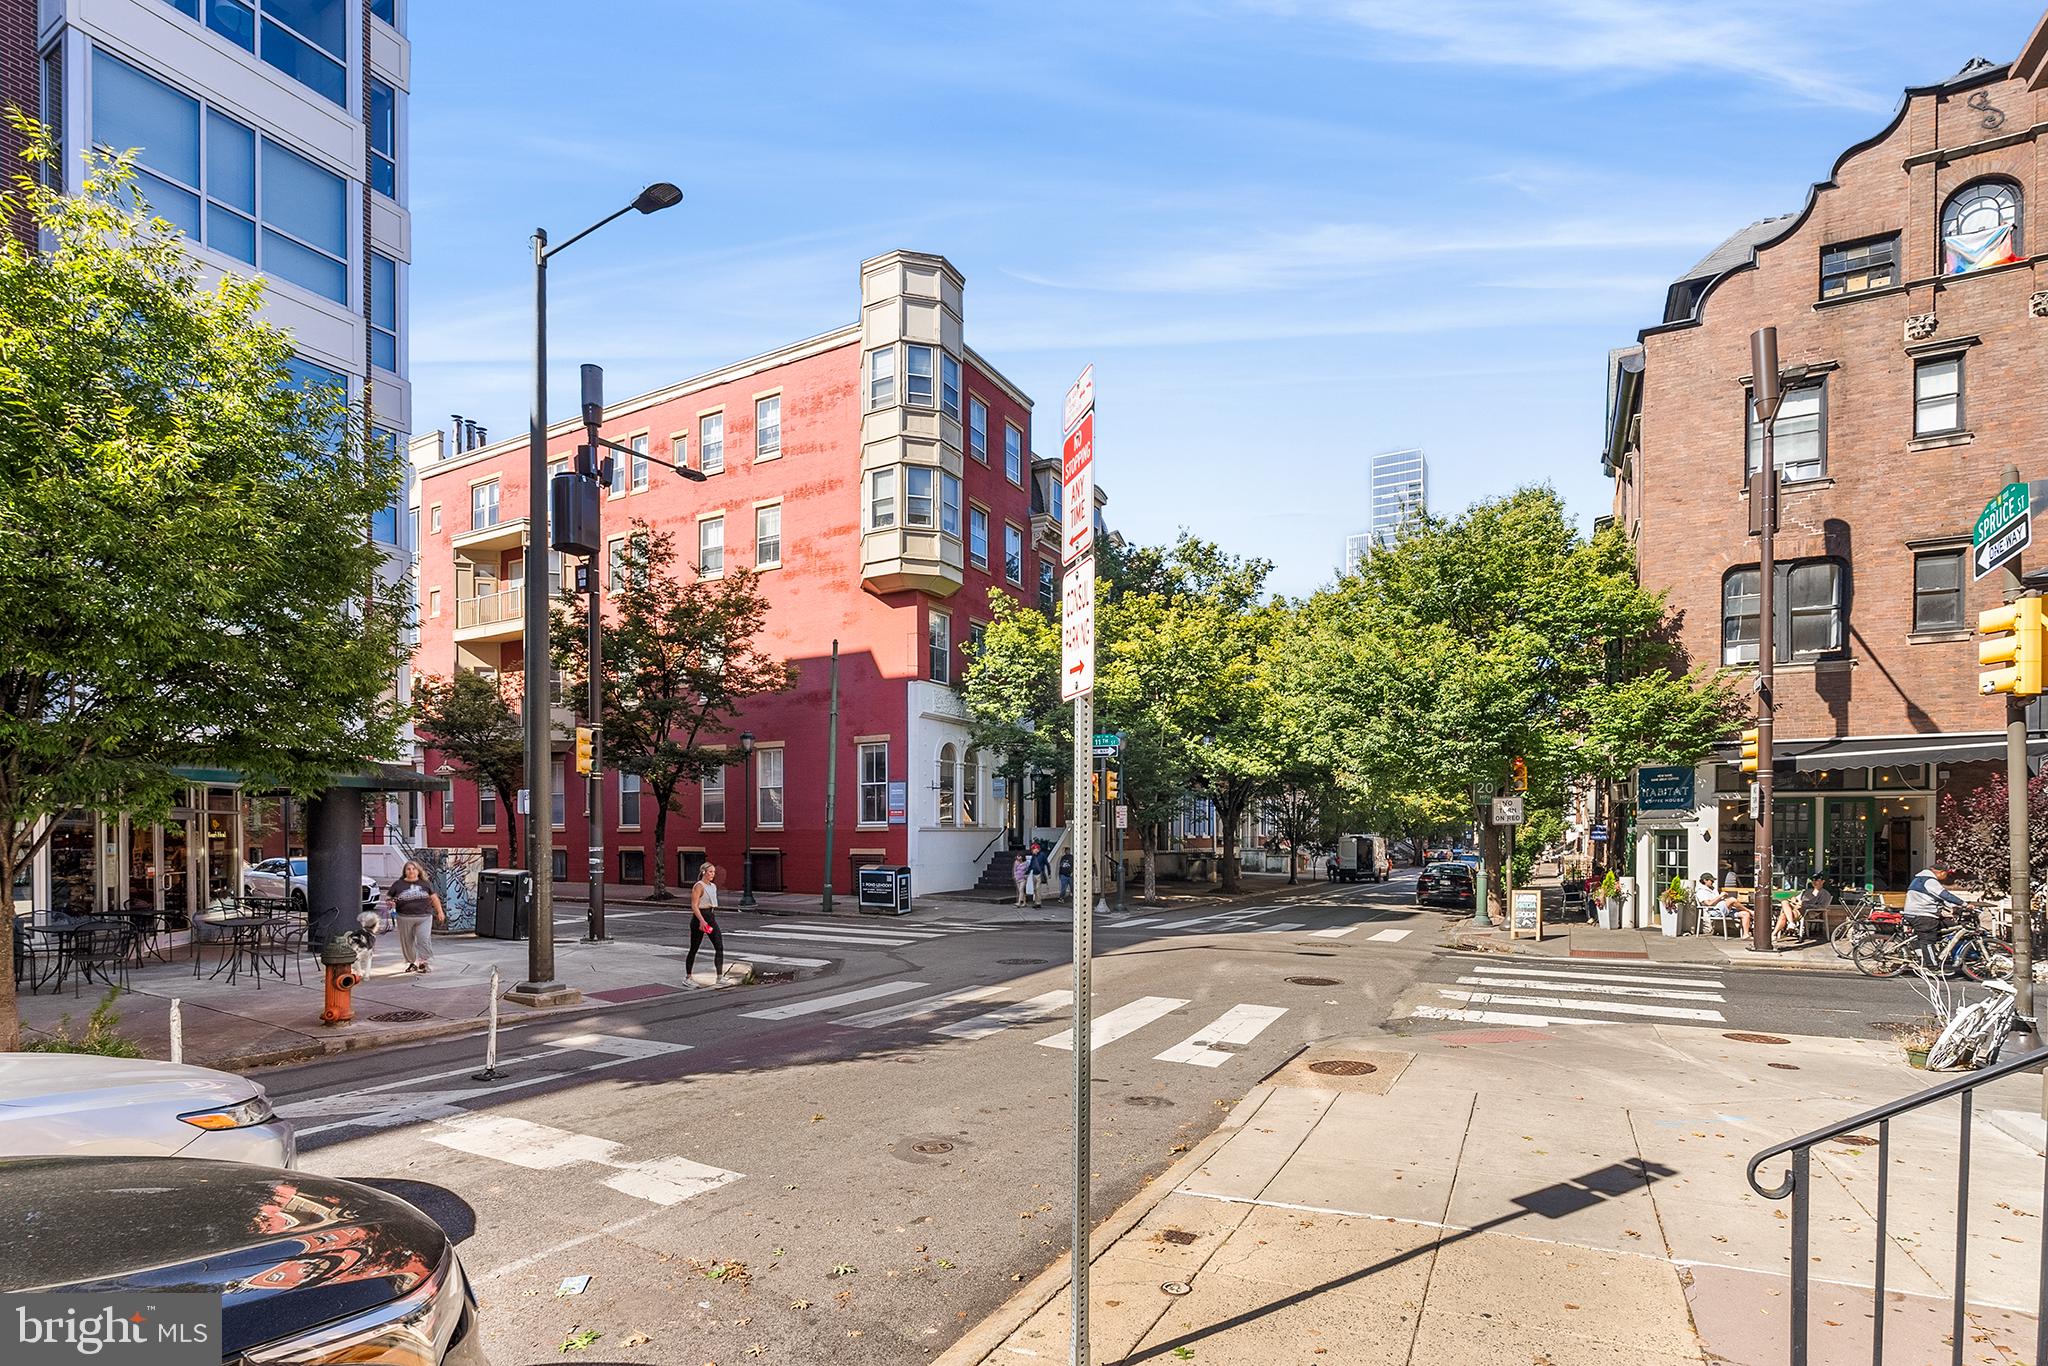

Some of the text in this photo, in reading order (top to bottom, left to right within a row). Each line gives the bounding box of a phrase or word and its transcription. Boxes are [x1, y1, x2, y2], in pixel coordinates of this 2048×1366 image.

[1073, 430, 1083, 452] NO
[1065, 441, 1091, 481] STOPPING
[1071, 475, 1085, 505] ANY
[1070, 499, 1086, 529] TIME
[1978, 497, 2015, 542] SPRUCE
[2017, 495, 2025, 512] ST
[1989, 525, 2023, 560] ONE WAY
[1066, 617, 1090, 649] PARKING
[1477, 782, 1494, 794] 20
[1641, 786, 1690, 797] HABITAT
